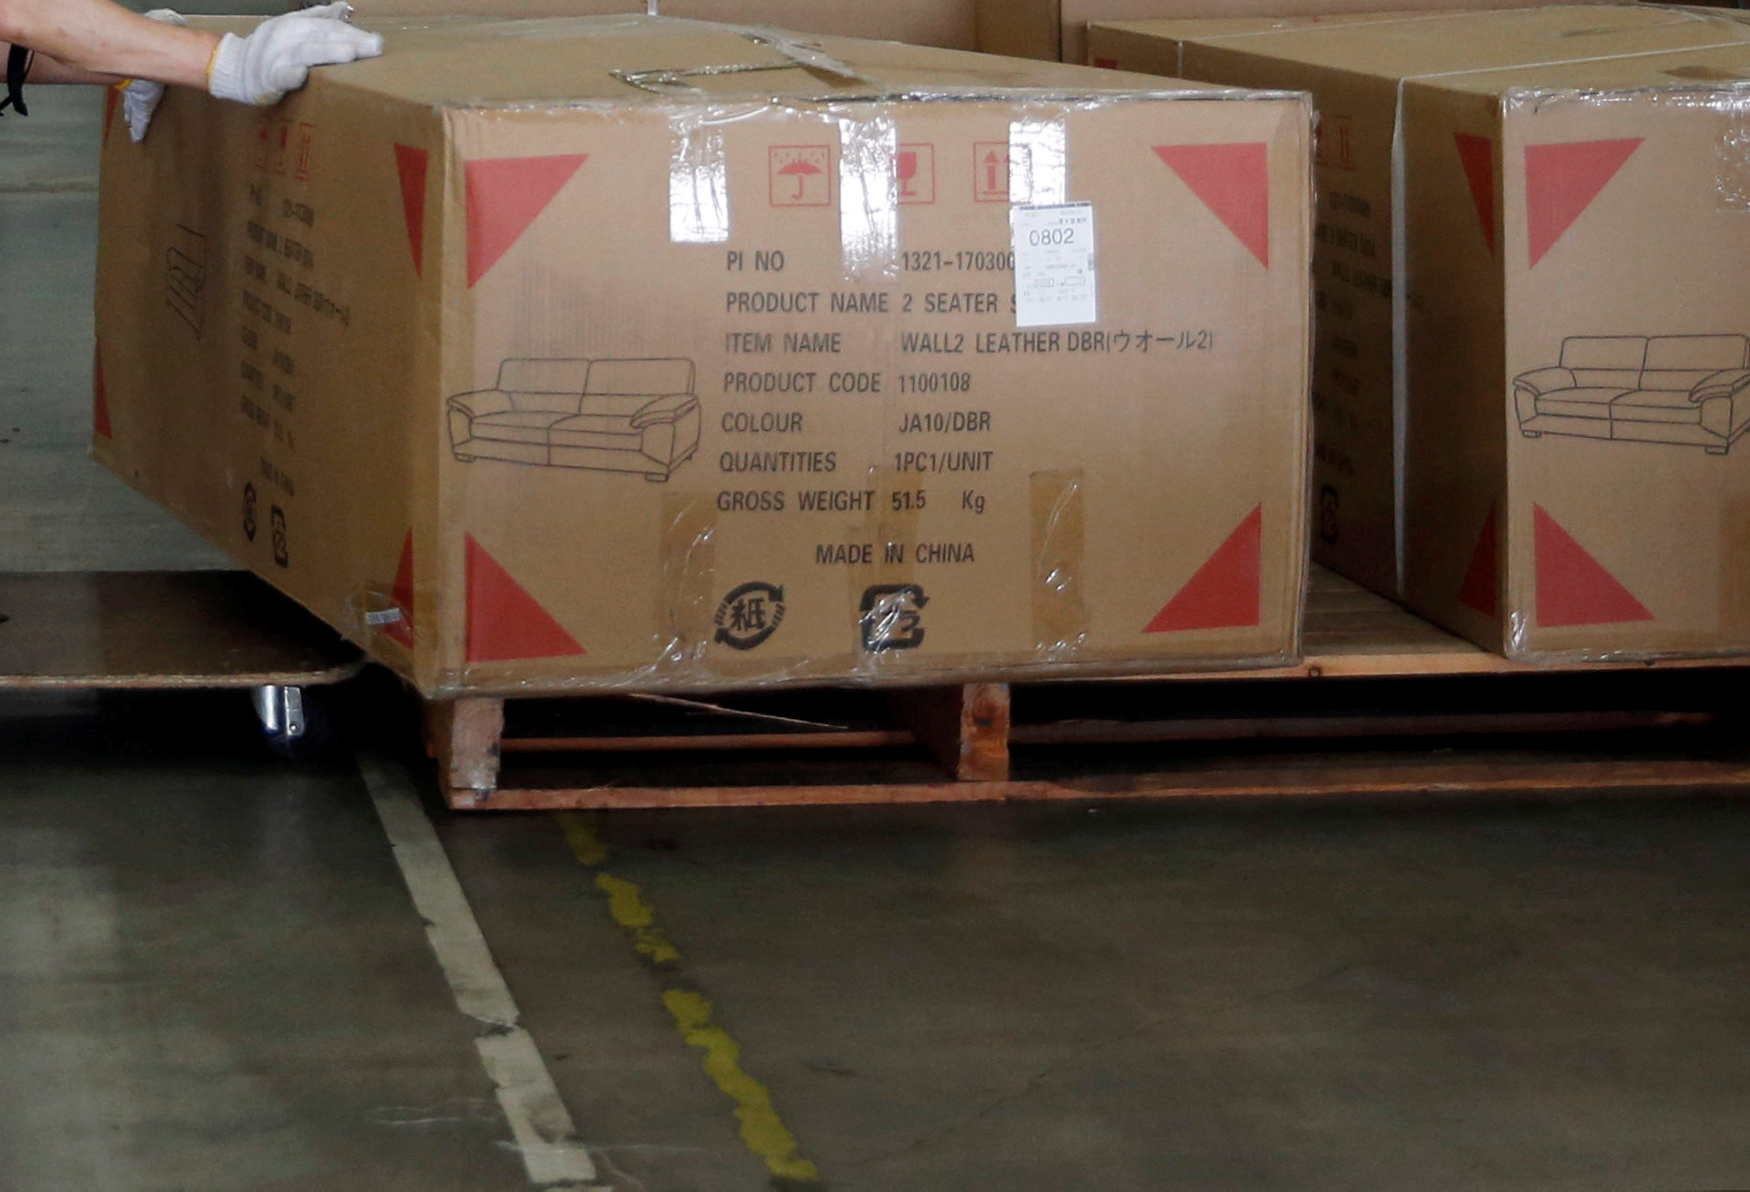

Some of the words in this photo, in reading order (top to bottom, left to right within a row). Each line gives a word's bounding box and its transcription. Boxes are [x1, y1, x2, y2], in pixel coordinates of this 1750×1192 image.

[1029, 228, 1075, 246] 0802
[726, 251, 744, 272] PI
[755, 251, 785, 272] NO
[726, 292, 819, 314] PRODUCT
[830, 292, 889, 314] NAME
[902, 293, 912, 314] 2
[924, 292, 999, 314] SEATER
[725, 333, 772, 354] ITEM
[783, 333, 841, 354] NAME
[900, 332, 965, 354] WALL2
[976, 331, 1060, 354] LEATHER
[724, 372, 816, 393] PRODUCT
[829, 372, 881, 393] CODE
[899, 372, 971, 393] 1100108
[721, 412, 803, 433] COLOUR
[899, 411, 991, 433] JA10/DBR
[719, 452, 837, 473] QUANTITIES
[895, 451, 993, 473] 1PC1/UNIT
[717, 491, 785, 511] GROSS
[799, 490, 875, 510] WEIGHT
[891, 490, 926, 510] 51.5
[962, 490, 985, 514] Kg
[815, 544, 873, 564] MADE
[885, 543, 904, 564] IN
[915, 543, 975, 564] CHINA
